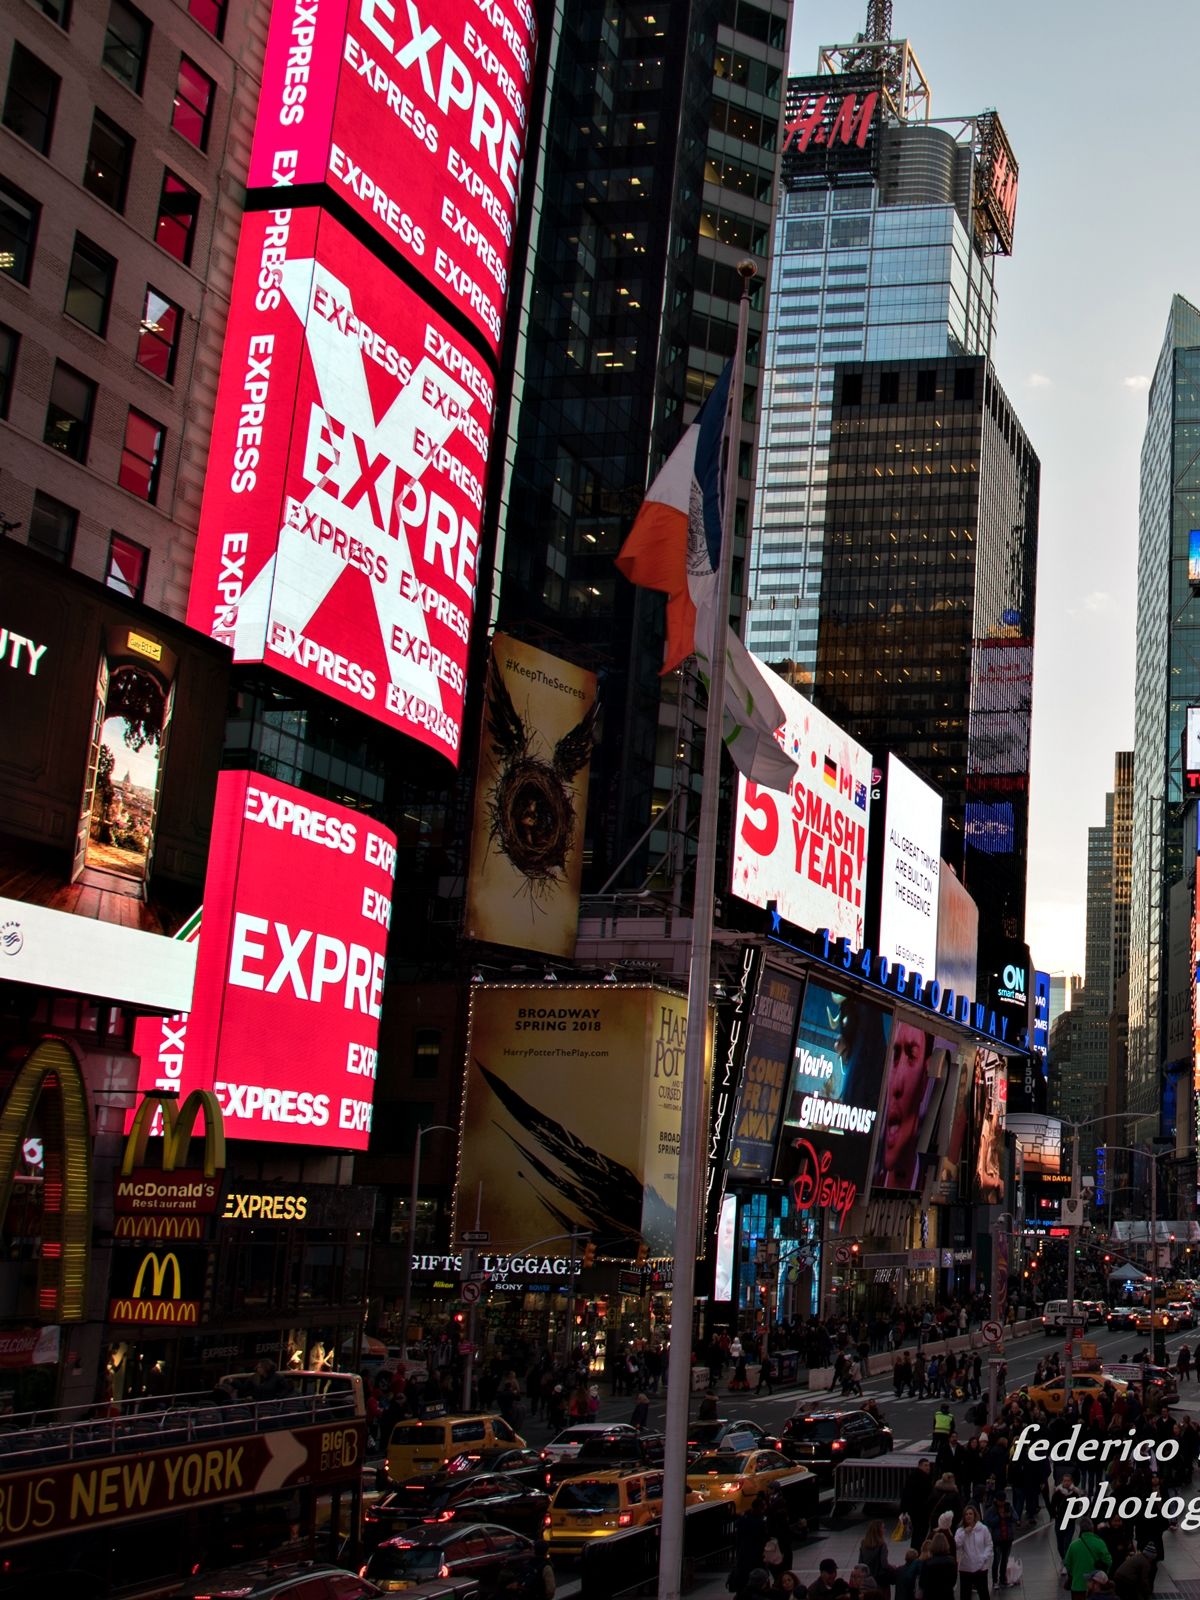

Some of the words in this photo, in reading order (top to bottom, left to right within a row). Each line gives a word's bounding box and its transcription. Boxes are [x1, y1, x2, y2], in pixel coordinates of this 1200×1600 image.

[473, 0, 530, 84] XPRESS
[343, 33, 439, 153] EXPRESS
[463, 21, 527, 129] EXPRESS
[783, 91, 879, 153] H&M
[329, 143, 426, 256] EXPRESS
[446, 146, 512, 247] EXPRESS
[441, 195, 507, 295] EXPRESS
[434, 247, 501, 343] EXPRESS
[313, 286, 413, 386] EXPRESS
[424, 323, 494, 415] EXPRESS
[231, 334, 275, 493] EXPRESS
[421, 375, 489, 463] EXPRESS
[412, 427, 483, 511] EXPRESS
[283, 495, 389, 584] EXPRESS
[399, 569, 470, 645] EXPRESS
[267, 621, 376, 700] EXPRESS
[390, 624, 464, 696] EXPRESS
[505, 658, 587, 701] #KeepTheSecrets
[385, 681, 459, 751] EXPRESS
[245, 787, 356, 854] EXPRESS
[741, 781, 779, 857] 5
[791, 782, 855, 856] SMASH
[792, 819, 866, 908] YEAR!
[890, 828, 901, 849] ALL
[901, 836, 920, 862] GREAT
[920, 850, 939, 876] THINGS
[894, 857, 907, 878] ARE
[907, 866, 924, 887] BUILT
[894, 881, 906, 902] THE
[906, 888, 931, 917] ESSENCE
[818, 928, 889, 985] 1540
[897, 963, 1010, 1041] BROADWAY
[1003, 964, 1025, 992] ON
[515, 1020, 567, 1031] SPRING
[573, 1020, 602, 1031] 2018
[518, 1008, 601, 1019] BROADWAY
[503, 1047, 609, 1058] HarryPotterThePlay.com
[749, 1056, 786, 1087] COME
[795, 1046, 834, 1079] "You're
[659, 1085, 681, 1101] CURSED
[799, 1090, 877, 1134] ginormous"
[658, 1143, 681, 1155] SPRING
[659, 1131, 681, 1142] BROAD
[737, 1110, 778, 1142] AWAY
[117, 1181, 215, 1198] McDonald's
[132, 1198, 197, 1209] Restaurant
[222, 1193, 308, 1220] EXPRESS
[432, 1280, 455, 1290] Nikon
[483, 1256, 582, 1276] LUGGAGE
[490, 1273, 508, 1283] NY
[495, 1283, 523, 1292] SONY
[320, 1451, 342, 1471] BUS
[321, 1430, 343, 1451] BIG
[70, 1460, 155, 1520] NEW
[164, 1446, 244, 1502] YORK
